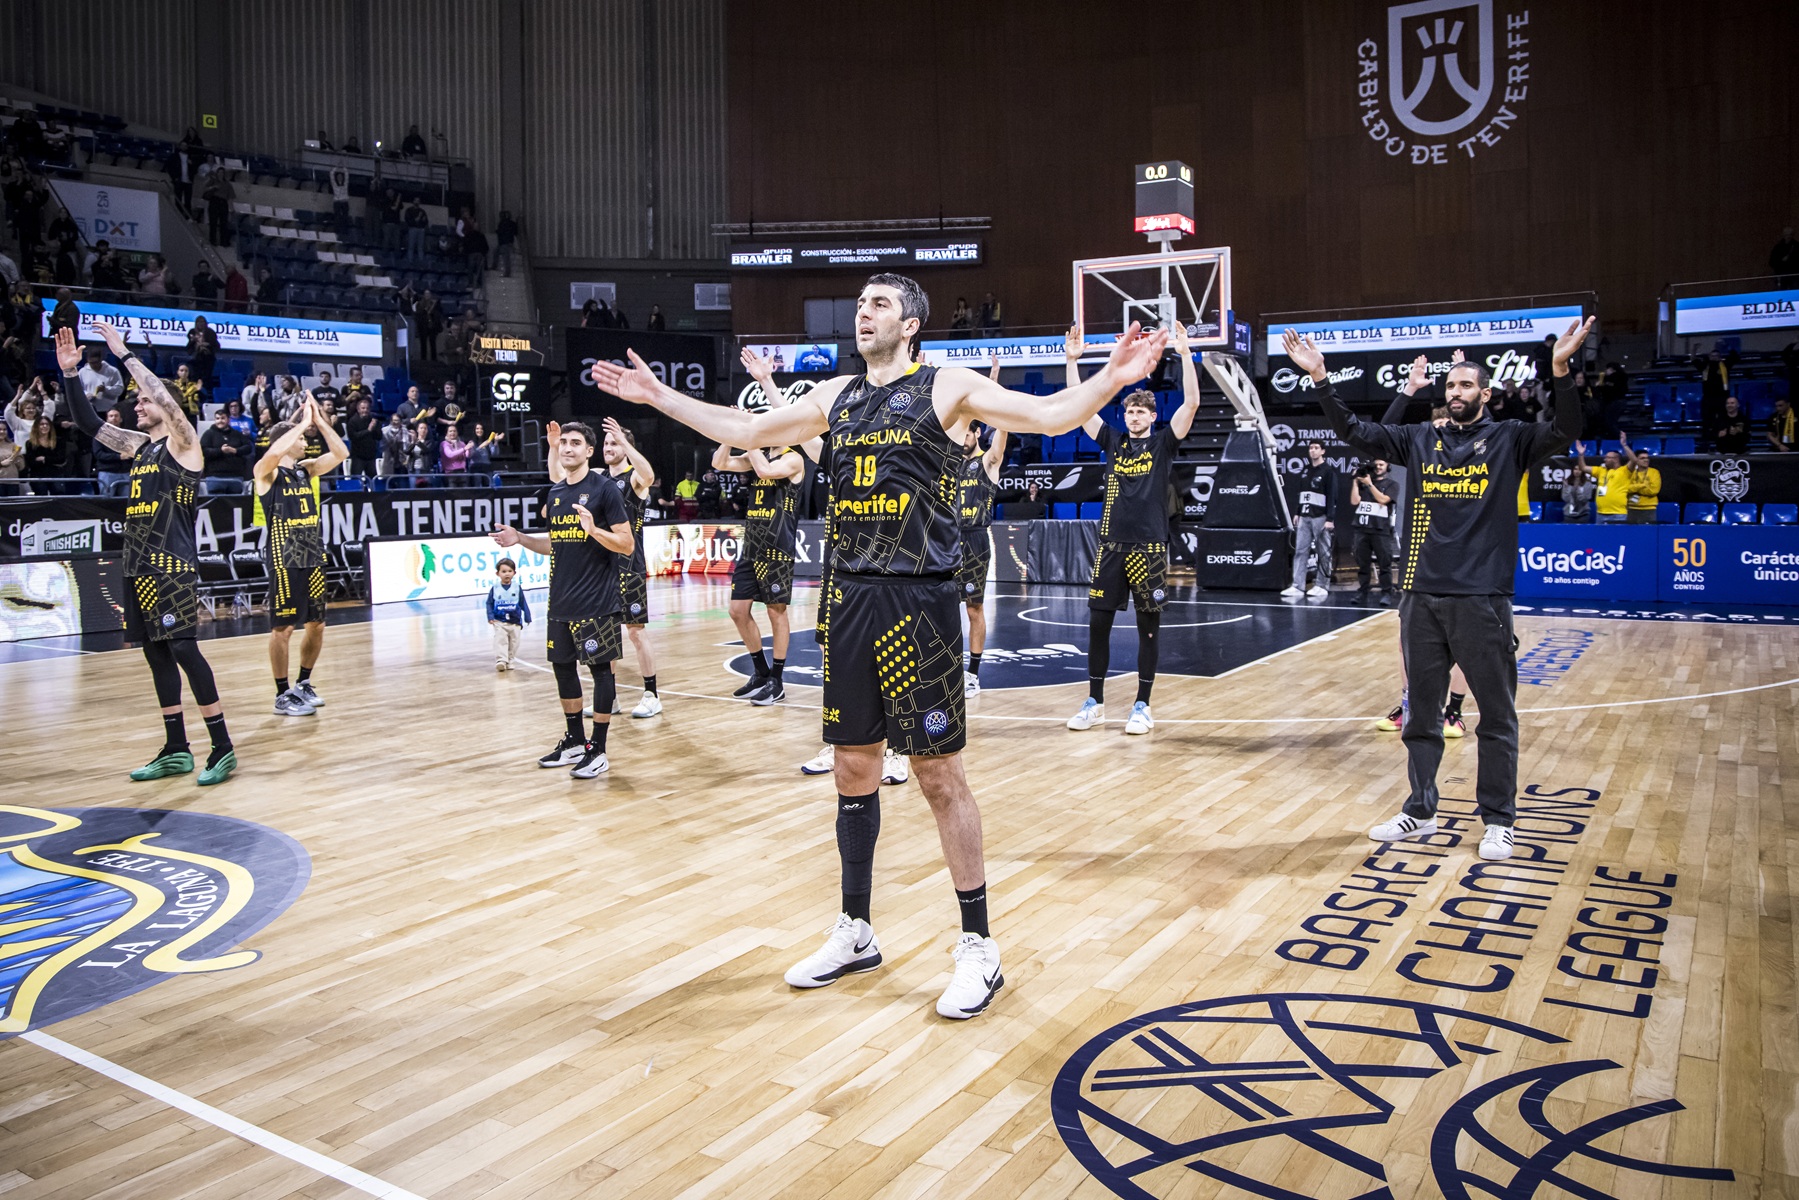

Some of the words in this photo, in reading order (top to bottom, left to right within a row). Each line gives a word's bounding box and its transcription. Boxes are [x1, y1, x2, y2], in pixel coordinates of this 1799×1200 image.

[1357, 38, 1405, 156] CABILDO
[1410, 143, 1448, 165] DE
[1457, 10, 1529, 158] TENERIFE
[94, 218, 139, 237] DXT
[763, 248, 792, 256] grupo
[801, 248, 852, 257] CONSTRUCCIÓN
[856, 247, 907, 255] ESCENOGRAFÍA
[948, 243, 978, 251] grupo
[731, 254, 793, 265] BRAWLER
[829, 255, 879, 263] DISTRIBUIDORA
[915, 249, 978, 260] BRAWLER
[1742, 303, 1763, 315] EL
[1765, 299, 1796, 314] DÍA
[139, 317, 158, 329] EL
[161, 317, 187, 332] DÍA
[215, 321, 241, 336] DÍA
[1391, 326, 1407, 337] EL
[1409, 323, 1432, 336] DÍA
[1440, 324, 1456, 334] EL
[1458, 320, 1481, 333] DÍA
[1490, 320, 1507, 331] EL
[1509, 316, 1533, 329] DÍA
[247, 325, 265, 337] EL
[267, 325, 291, 339] DÍA
[298, 328, 314, 340] EL
[316, 328, 340, 342] DÍA
[1314, 328, 1336, 340] DÍA
[1342, 330, 1358, 340] EL
[1360, 326, 1382, 338] DÍA
[480, 337, 501, 349] VISITA
[501, 338, 531, 350] NUESTRA
[1003, 344, 1022, 355] DÍA
[1029, 344, 1045, 354] EL
[1046, 342, 1066, 353] DÍA
[495, 350, 518, 362] TIENDA
[946, 348, 960, 357] EL
[962, 345, 982, 356] DÍA
[492, 372, 531, 400] GF
[493, 401, 531, 412] HOTELES
[832, 434, 843, 450] LA
[845, 428, 912, 446] LAGUNA
[853, 454, 877, 487] 19
[1422, 462, 1434, 475] LA
[1436, 462, 1489, 477] LAGUNA
[1360, 503, 1372, 513] HB
[392, 496, 539, 536] TENERIFE
[859, 513, 896, 522] emotions
[45, 530, 91, 551] FINISHER
[1207, 555, 1253, 564] EXPRESS
[1673, 538, 1707, 567] 50
[1543, 576, 1552, 584] 50
[1554, 575, 1571, 584] años
[1572, 576, 1600, 586] contigo
[1673, 568, 1705, 583] AÑOS
[1754, 567, 1799, 581] único
[86, 852, 168, 873] TFE
[1396, 784, 1601, 993] CHAMPIONS
[146, 868, 219, 930] LAGUNA
[1543, 865, 1678, 1019] LEAGUE
[77, 940, 161, 969] LA
